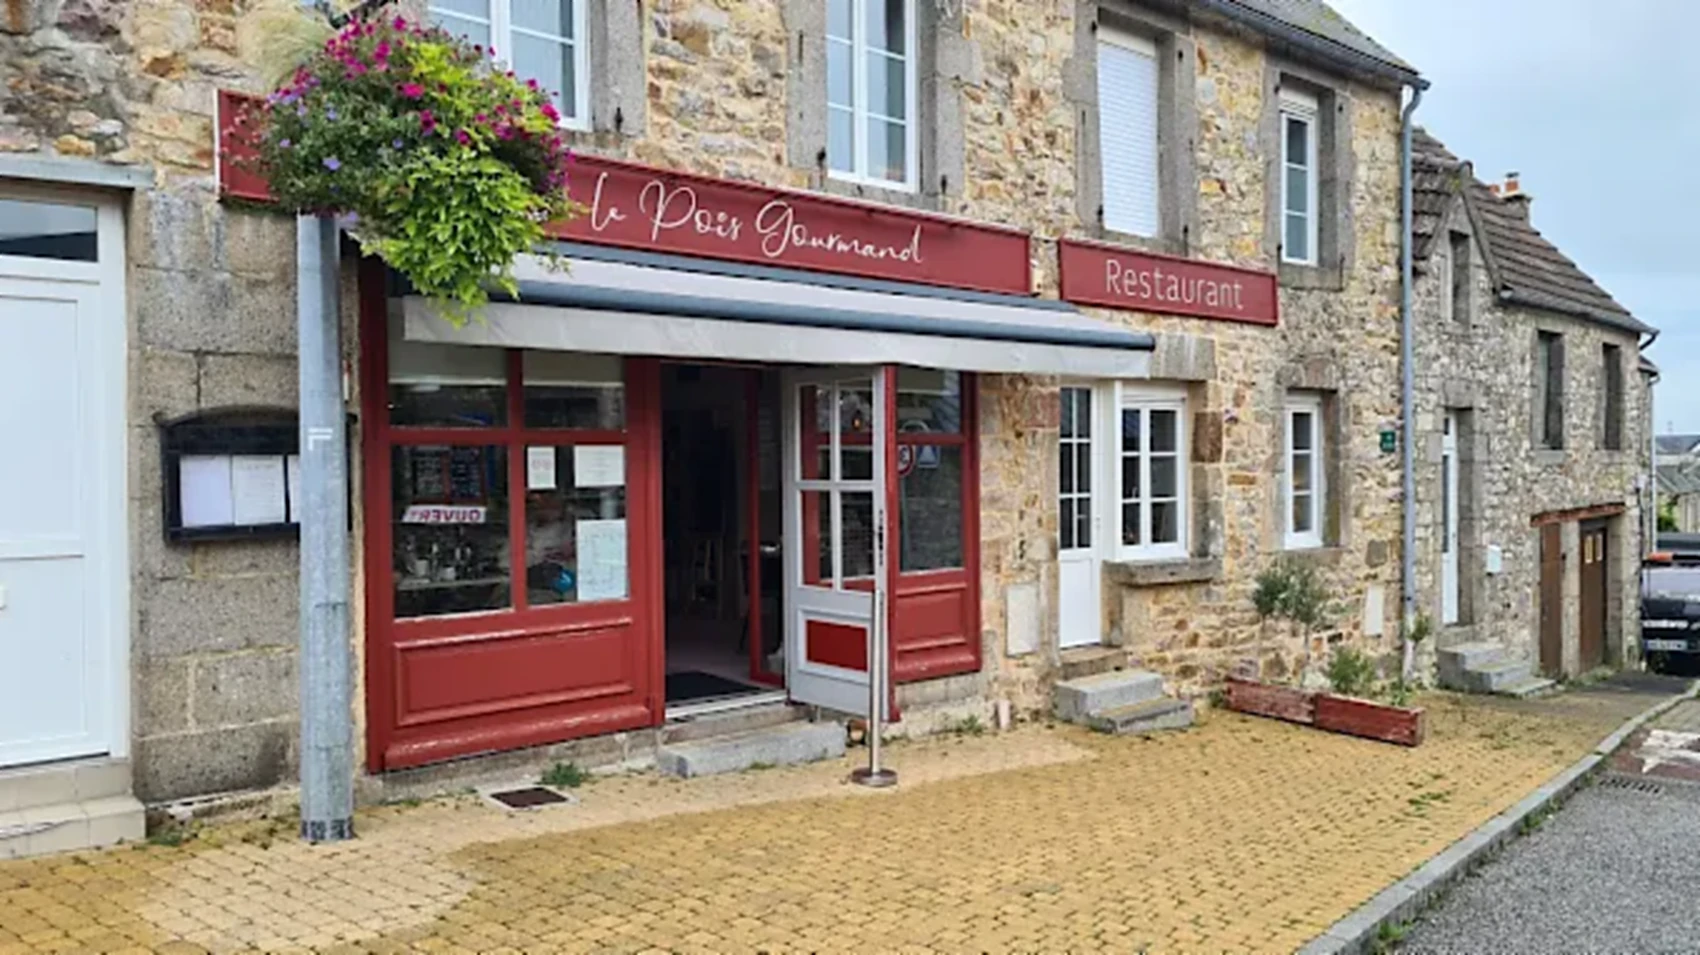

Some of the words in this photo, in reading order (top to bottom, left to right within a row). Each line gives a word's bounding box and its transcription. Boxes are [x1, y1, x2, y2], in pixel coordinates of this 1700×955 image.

[639, 179, 743, 242] Pois
[755, 200, 924, 264] Gourmand
[1105, 259, 1243, 310] Restaurant
